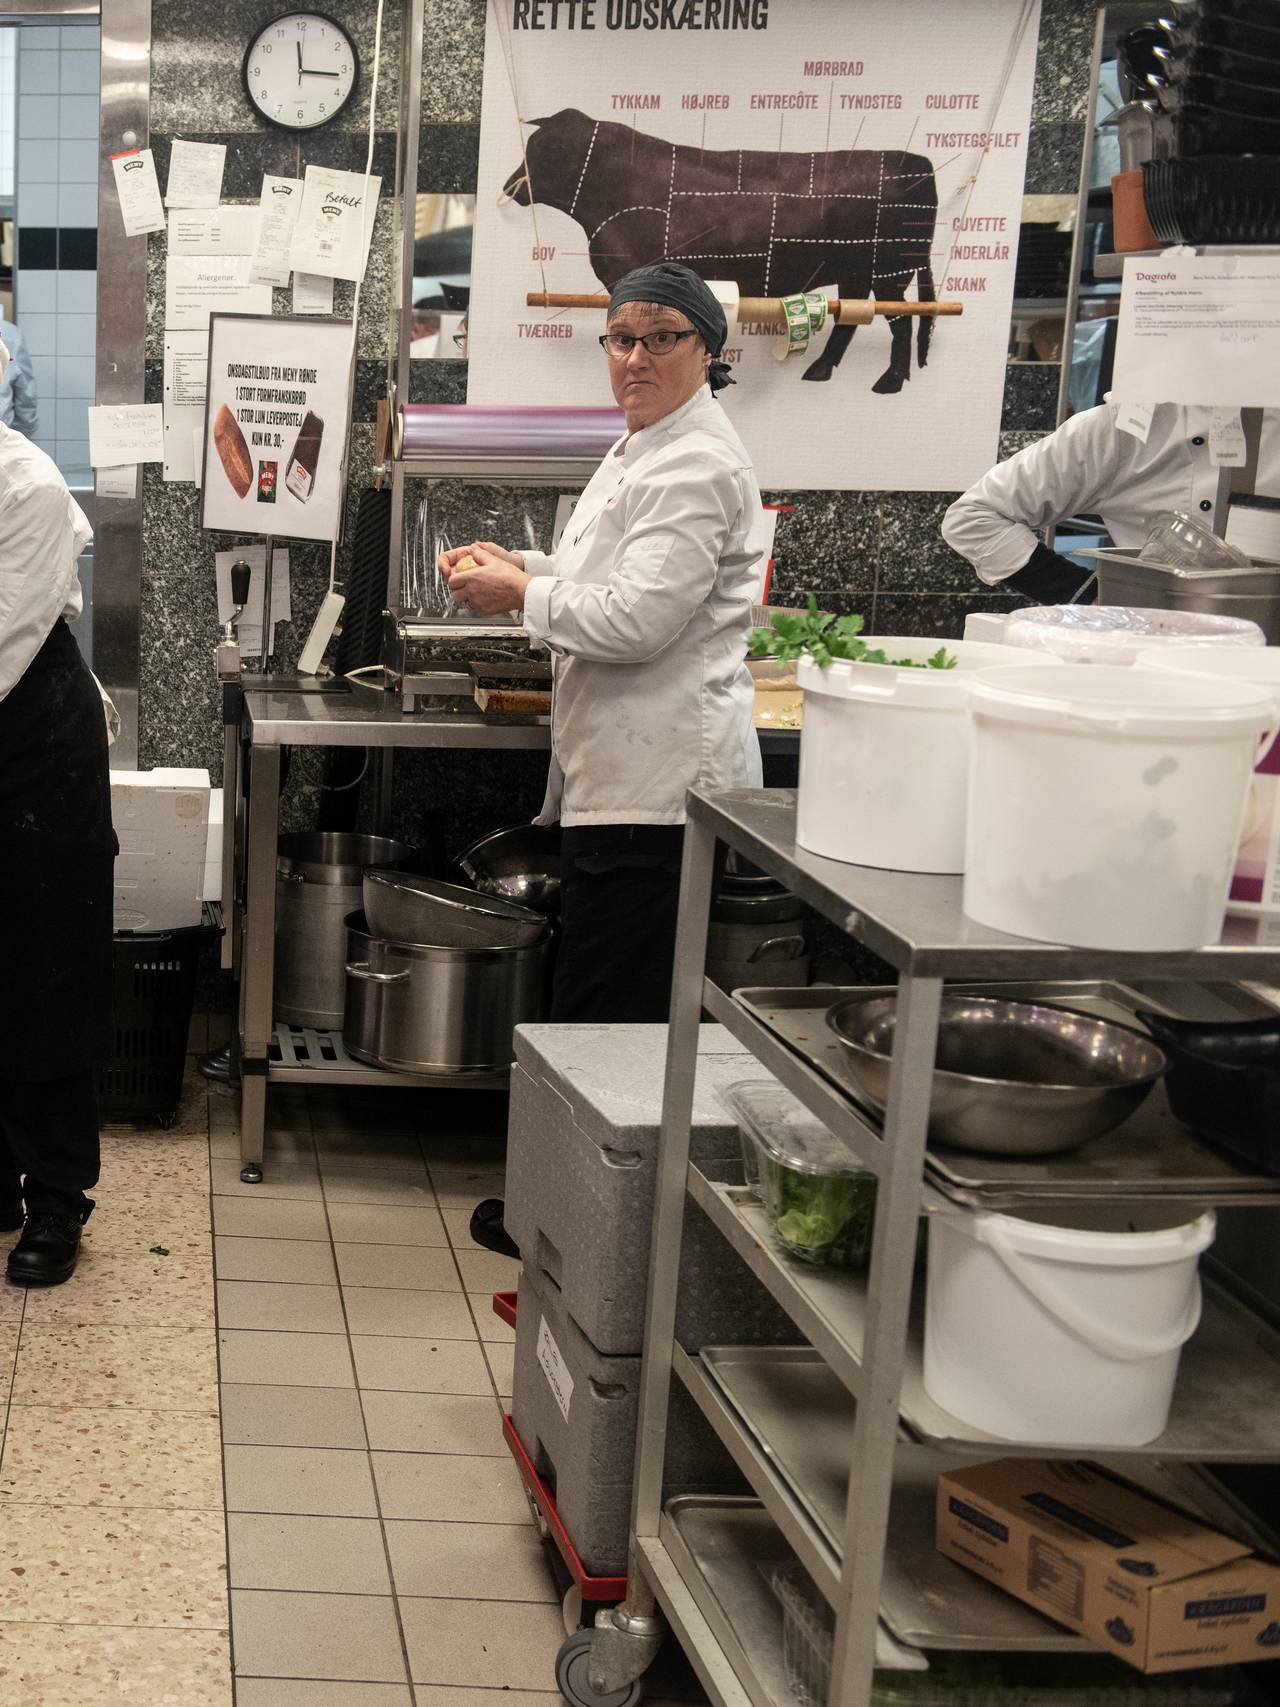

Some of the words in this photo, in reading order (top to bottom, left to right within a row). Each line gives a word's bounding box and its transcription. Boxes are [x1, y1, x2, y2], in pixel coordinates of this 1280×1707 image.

[513, 0, 597, 30] RETTE
[606, 0, 769, 30] UDSKÆRING
[277, 29, 285, 38] 11
[296, 21, 307, 31] 12
[261, 43, 273, 54] 10
[334, 41, 341, 52] 2
[254, 66, 261, 77] 9
[341, 64, 348, 74] 3
[804, 61, 864, 77] MØRBRAD
[261, 89, 268, 100] 8
[334, 88, 340, 97] 4
[750, 90, 819, 110] ENTRECÔTE
[276, 104, 284, 114] 7
[319, 103, 326, 113] 5
[611, 94, 661, 110] TYKKAM
[681, 94, 730, 110] HØJREB
[839, 94, 902, 110] TYNDSTEG
[925, 94, 980, 110] CULOTTE
[297, 109, 304, 119] 6
[926, 132, 1021, 149] TYKSTEGSFILET
[953, 217, 1006, 232] CUVETTE
[532, 246, 556, 261] BOV
[951, 241, 1010, 260] INDERLÅR
[946, 277, 987, 292] SKANK
[1136, 272, 1177, 284] Dagrofa
[517, 324, 573, 338] TVÆRREB
[227, 363, 270, 381] ONSDAGSTILBUD
[271, 366, 281, 381] FRA
[282, 367, 298, 382] MENY
[299, 368, 318, 384] RØNDE
[239, 386, 256, 402] STORT
[240, 408, 254, 423] STOR
[254, 409, 266, 425] LUN
[266, 409, 303, 427] LEVERPOSTEJ
[251, 431, 263, 446] KUN
